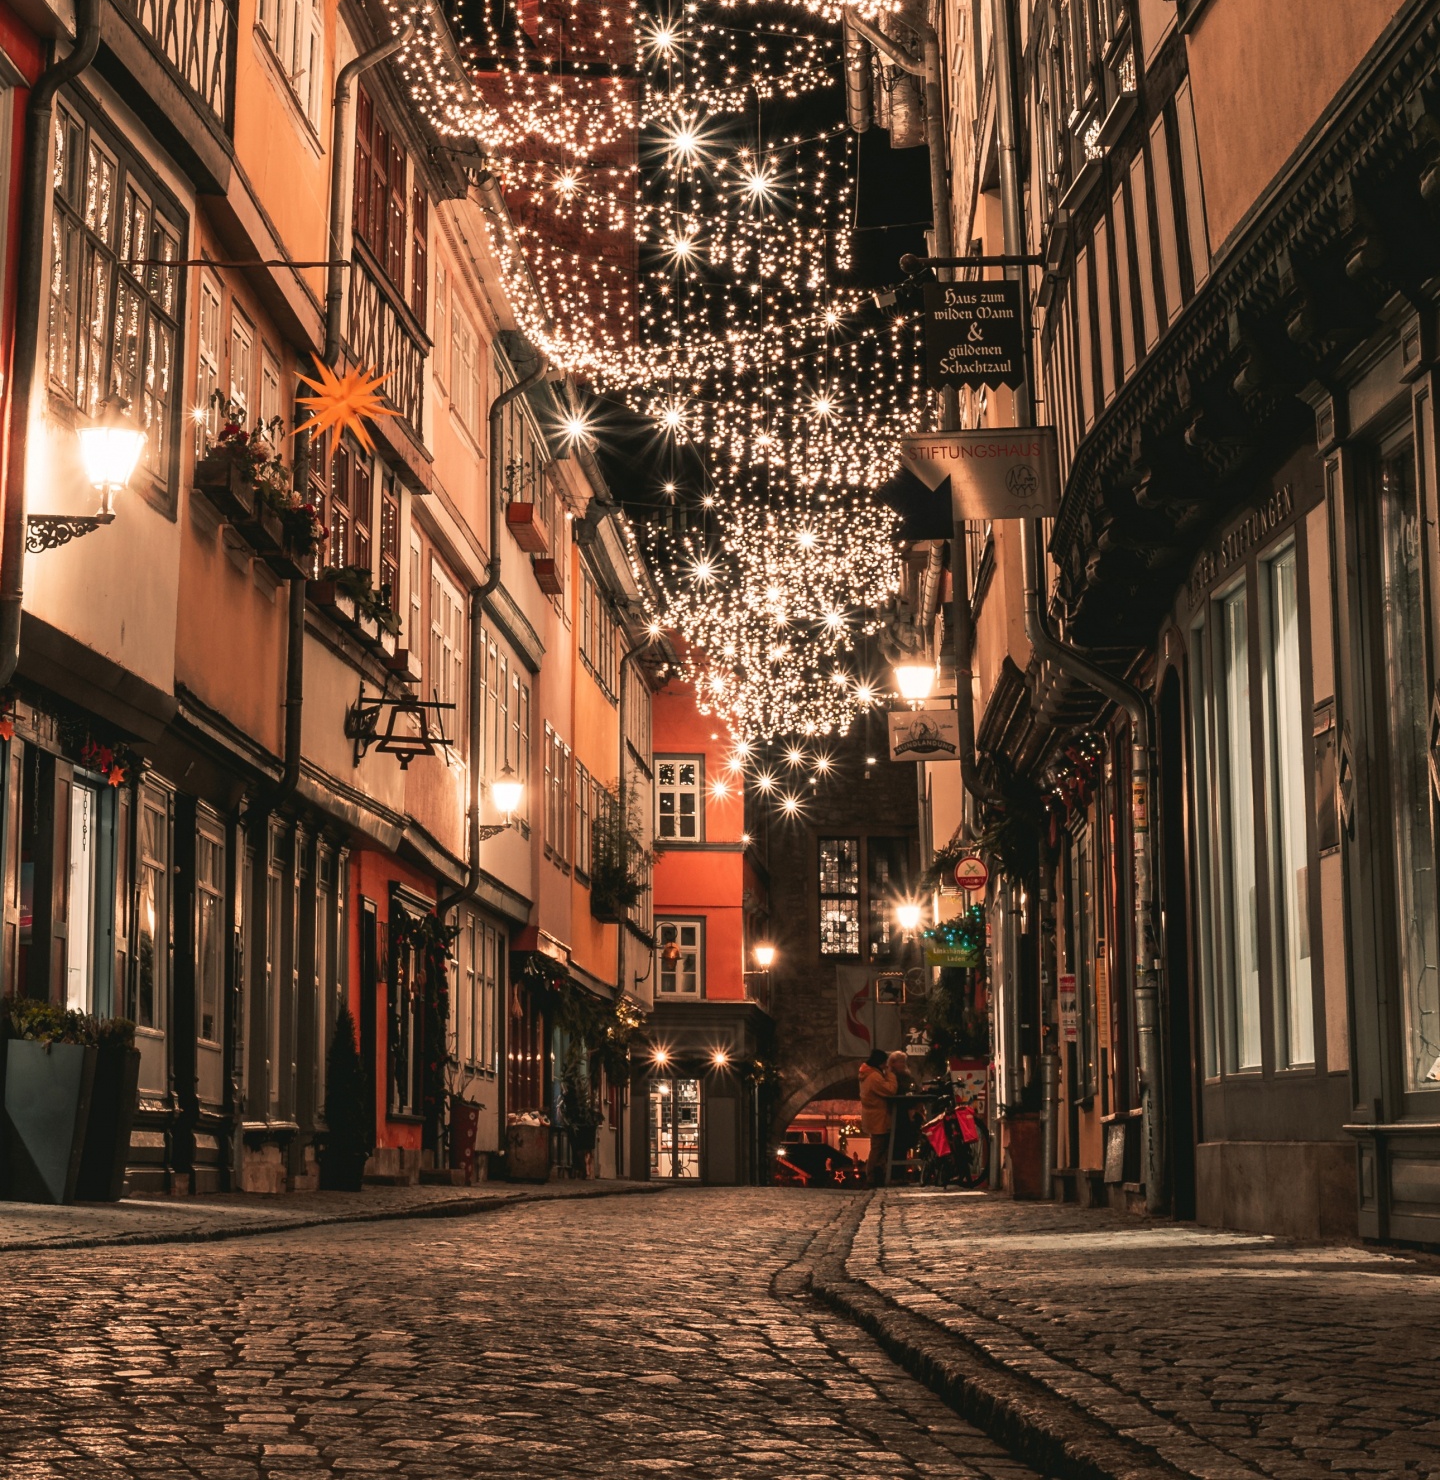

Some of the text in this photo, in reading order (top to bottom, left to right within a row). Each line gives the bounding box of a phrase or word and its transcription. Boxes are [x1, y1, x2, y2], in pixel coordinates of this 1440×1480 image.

[944, 288, 1005, 307] Haus zum
[934, 306, 1014, 320] wilden Mann
[967, 321, 984, 342] &
[948, 343, 1002, 360] güldenen
[939, 358, 1012, 374] Schachtzaul
[909, 442, 1041, 461] STIFTUNGSHAUS
[1221, 483, 1293, 569] STIFTUNGEN
[895, 739, 954, 754] MUNDLANDUNG
